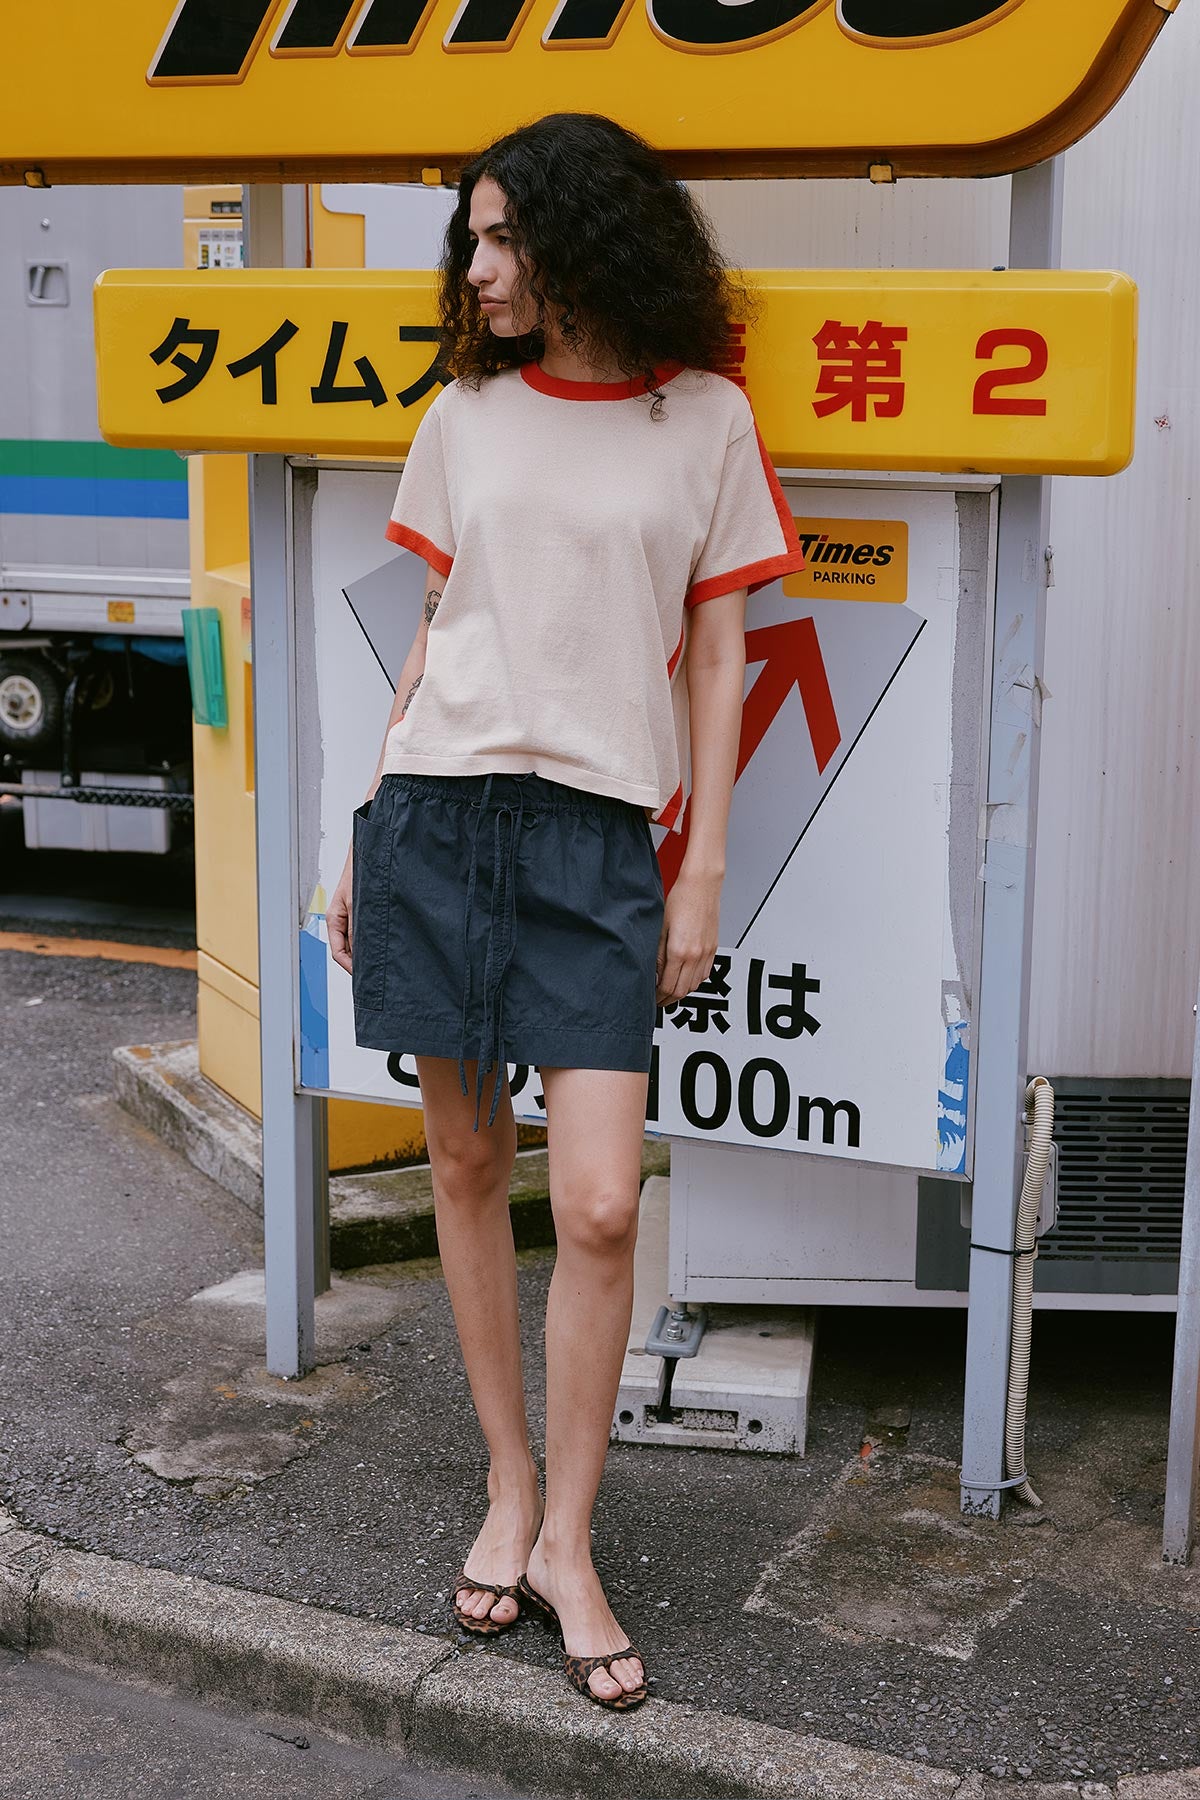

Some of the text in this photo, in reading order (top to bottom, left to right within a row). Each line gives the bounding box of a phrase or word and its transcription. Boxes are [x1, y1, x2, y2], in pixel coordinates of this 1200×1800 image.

[149, 317, 459, 408] タイムス
[799, 534, 895, 566] Times
[813, 571, 876, 585] PARKING
